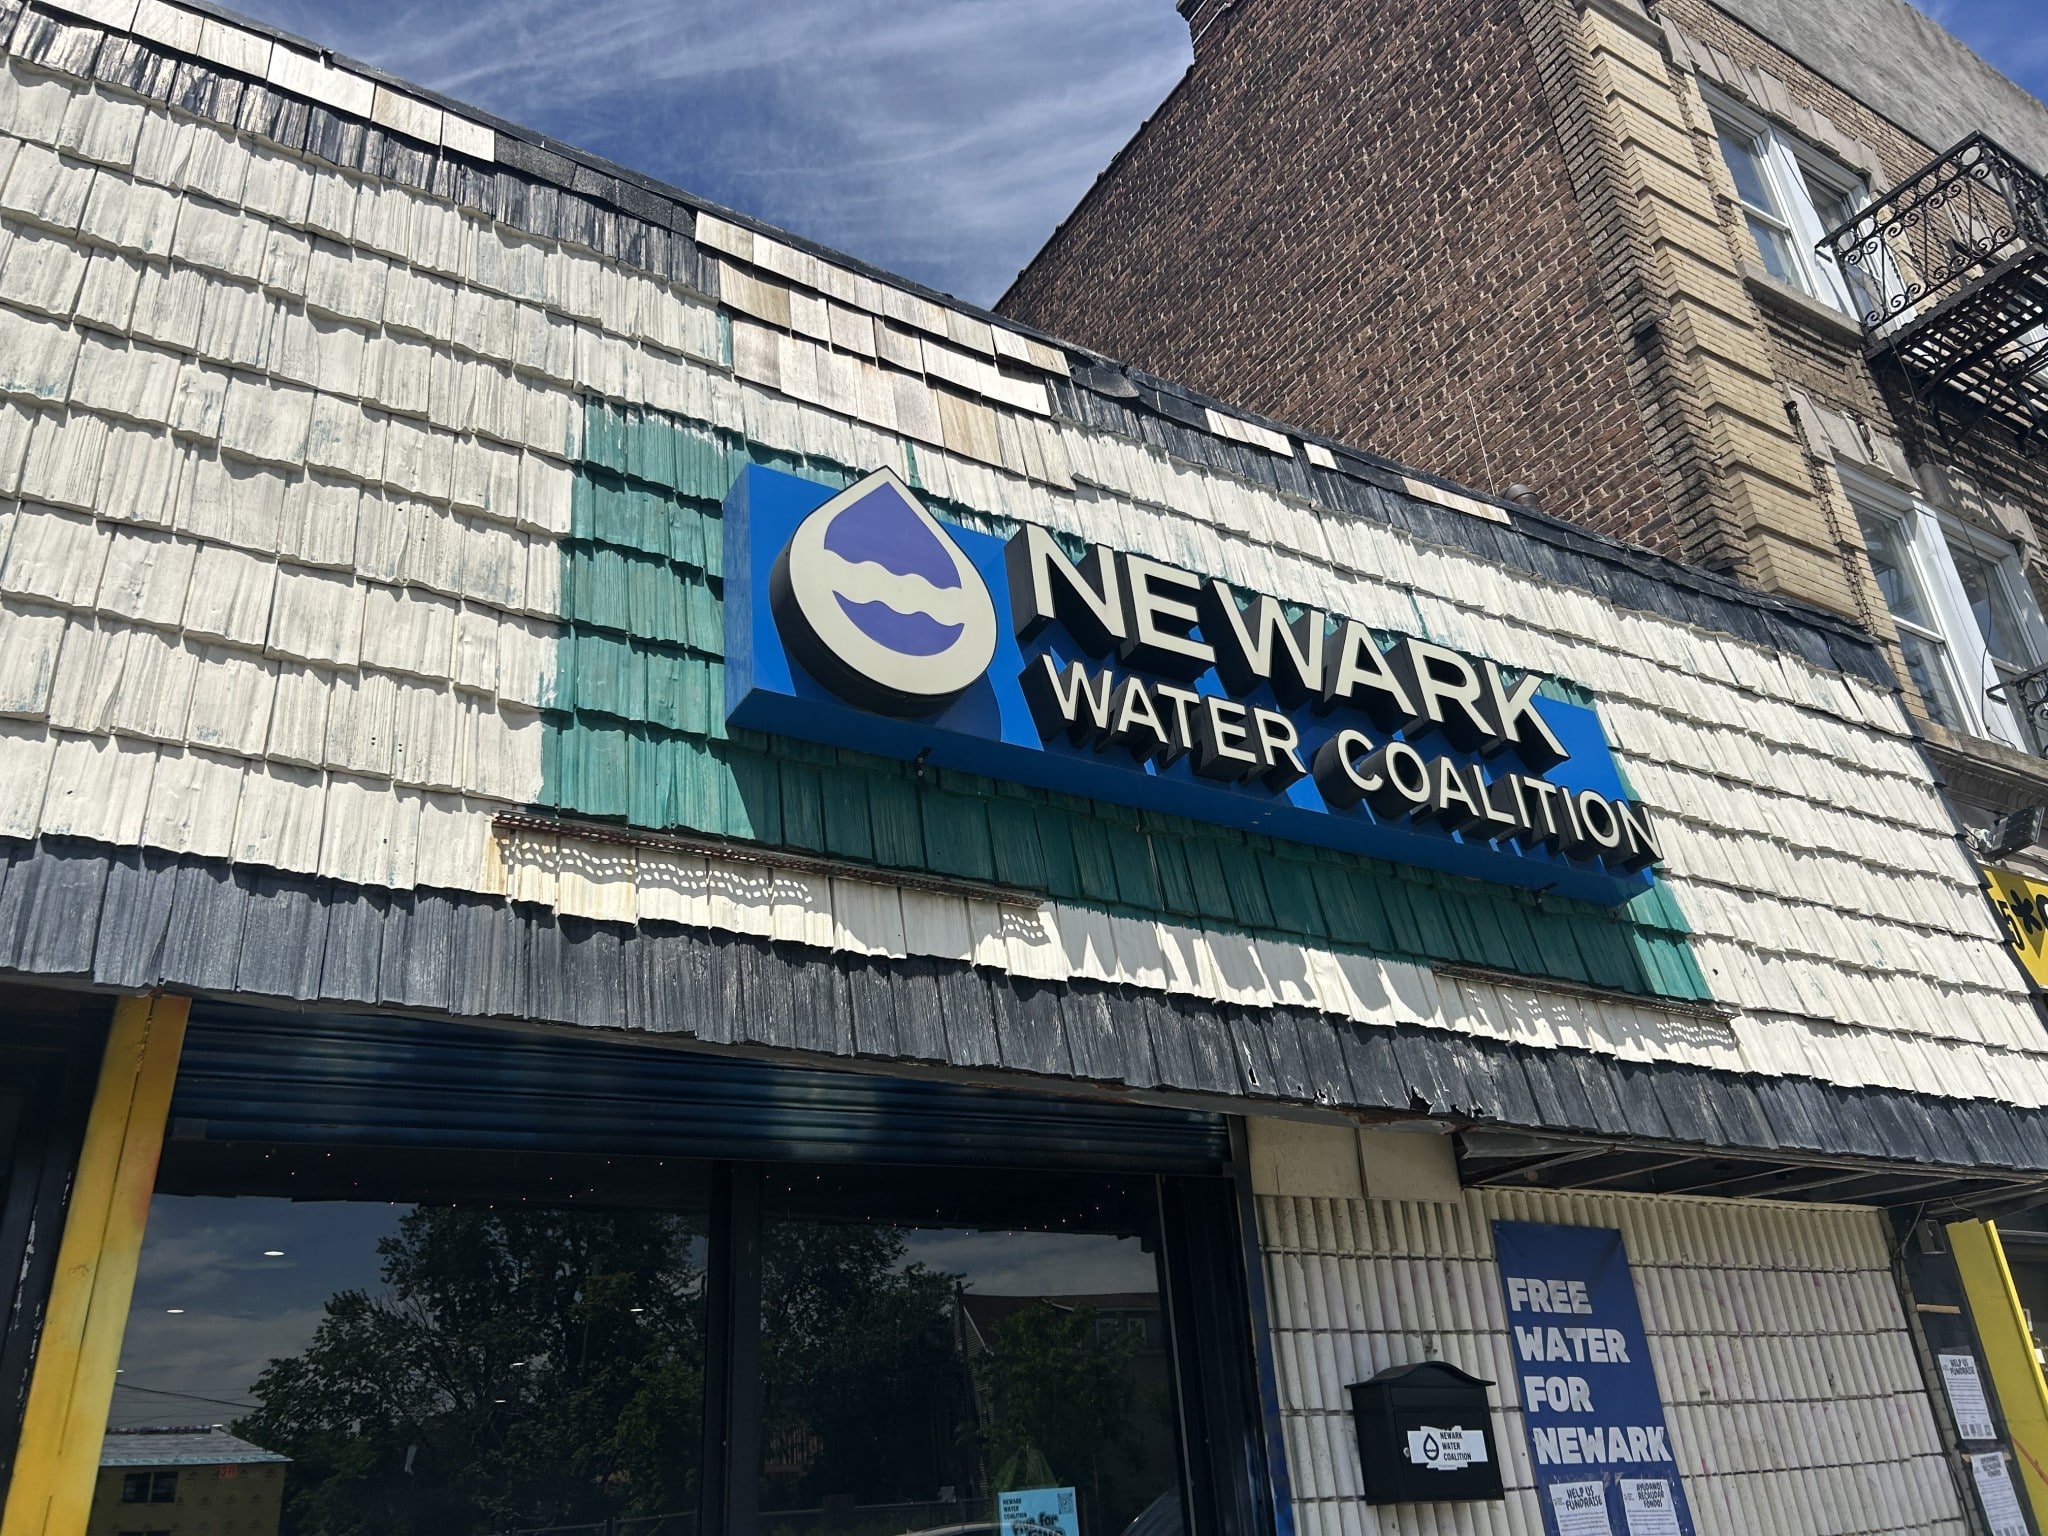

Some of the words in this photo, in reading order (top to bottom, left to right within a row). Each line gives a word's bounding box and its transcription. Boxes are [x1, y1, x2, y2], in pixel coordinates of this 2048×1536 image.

[1022, 523, 1570, 759] NEWARK
[1037, 653, 1307, 776] WATER
[1333, 729, 1664, 861] COALITION
[1507, 1277, 1593, 1314] FREE
[1514, 1326, 1631, 1363] WATER
[1524, 1376, 1594, 1412] FOR
[1442, 1442, 1461, 1450] WATER
[1532, 1427, 1673, 1464] NEWARK
[1565, 1495, 1602, 1511] FUNDRAISE
[1566, 1486, 1584, 1499] HELP
[1585, 1485, 1595, 1497] US
